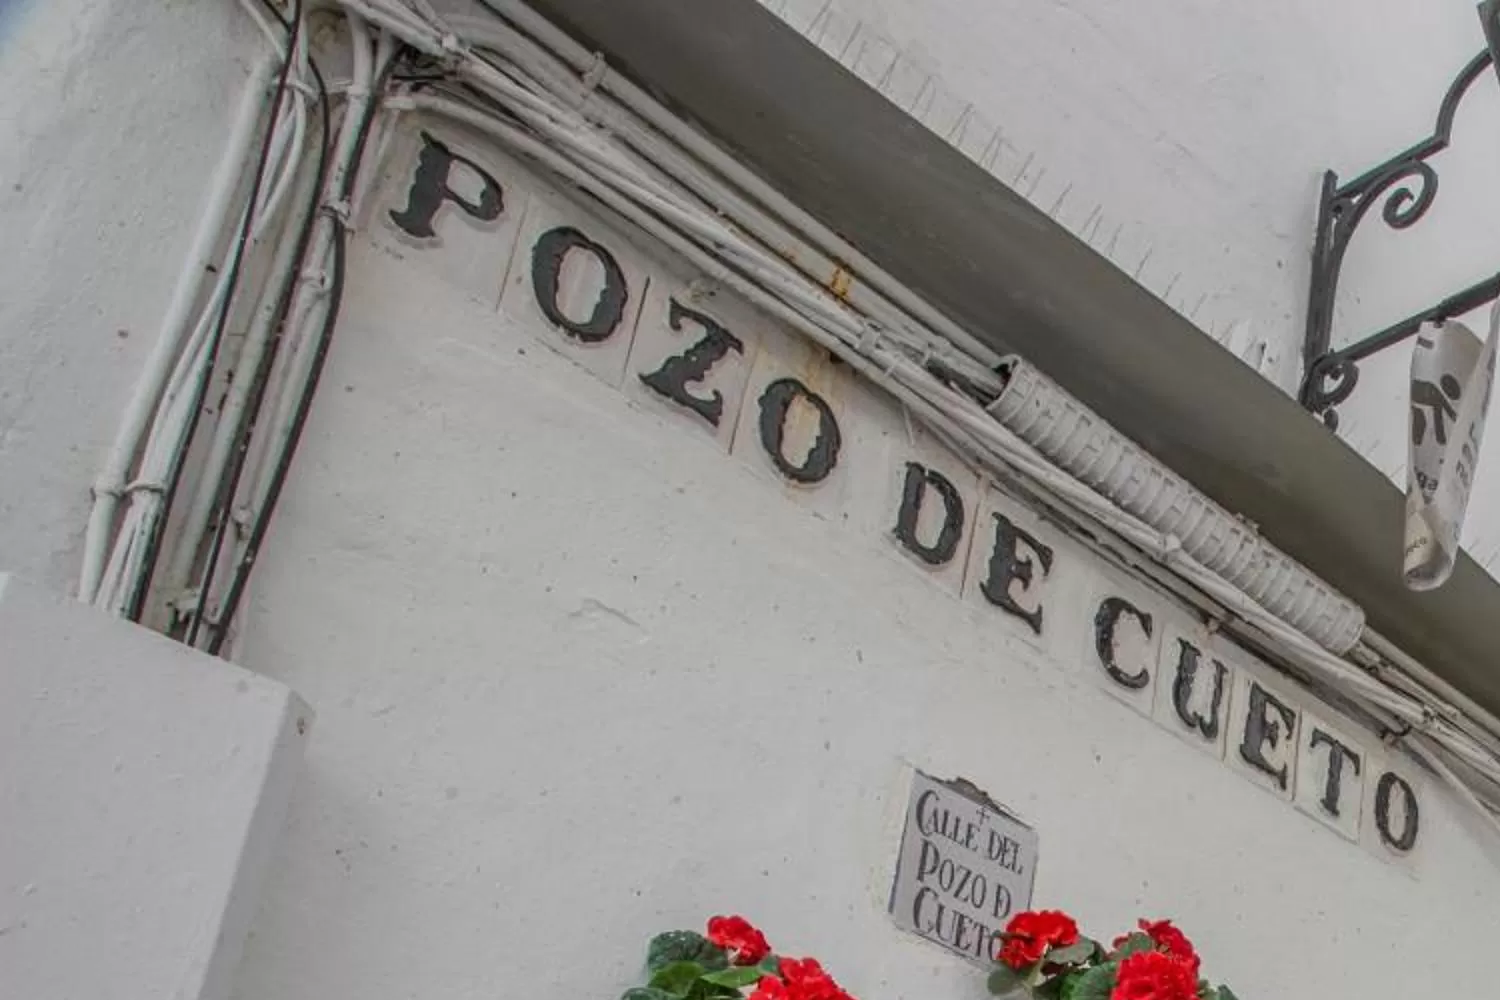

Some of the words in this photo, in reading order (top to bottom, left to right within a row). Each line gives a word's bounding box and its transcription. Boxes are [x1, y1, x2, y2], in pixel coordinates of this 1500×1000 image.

[388, 130, 842, 484] POZO
[894, 461, 1054, 634] DE
[1095, 596, 1420, 852] CUETO
[915, 838, 988, 909] POZO
[916, 789, 980, 852] CALLE
[986, 827, 1024, 875] DEL
